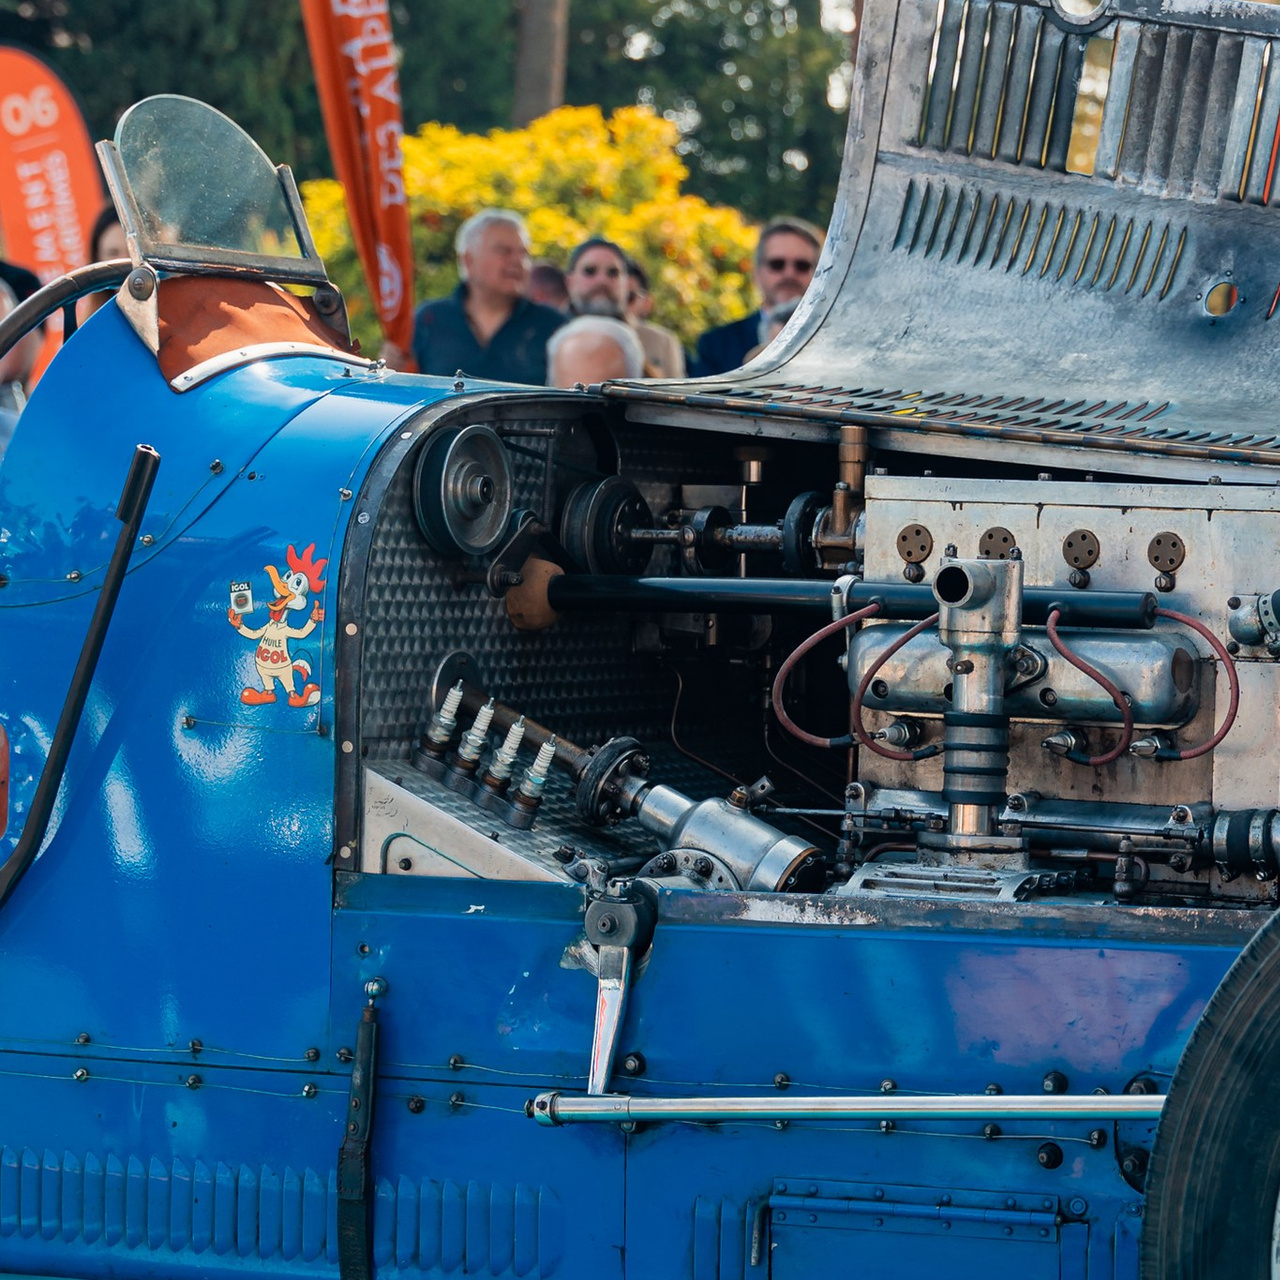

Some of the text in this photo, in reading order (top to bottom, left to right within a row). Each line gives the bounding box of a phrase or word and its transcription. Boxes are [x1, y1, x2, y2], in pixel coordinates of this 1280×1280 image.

[0, 84, 59, 136] 06
[231, 582, 249, 592] IGOL
[261, 637, 282, 648] HUILE
[256, 645, 288, 664] IGOL
